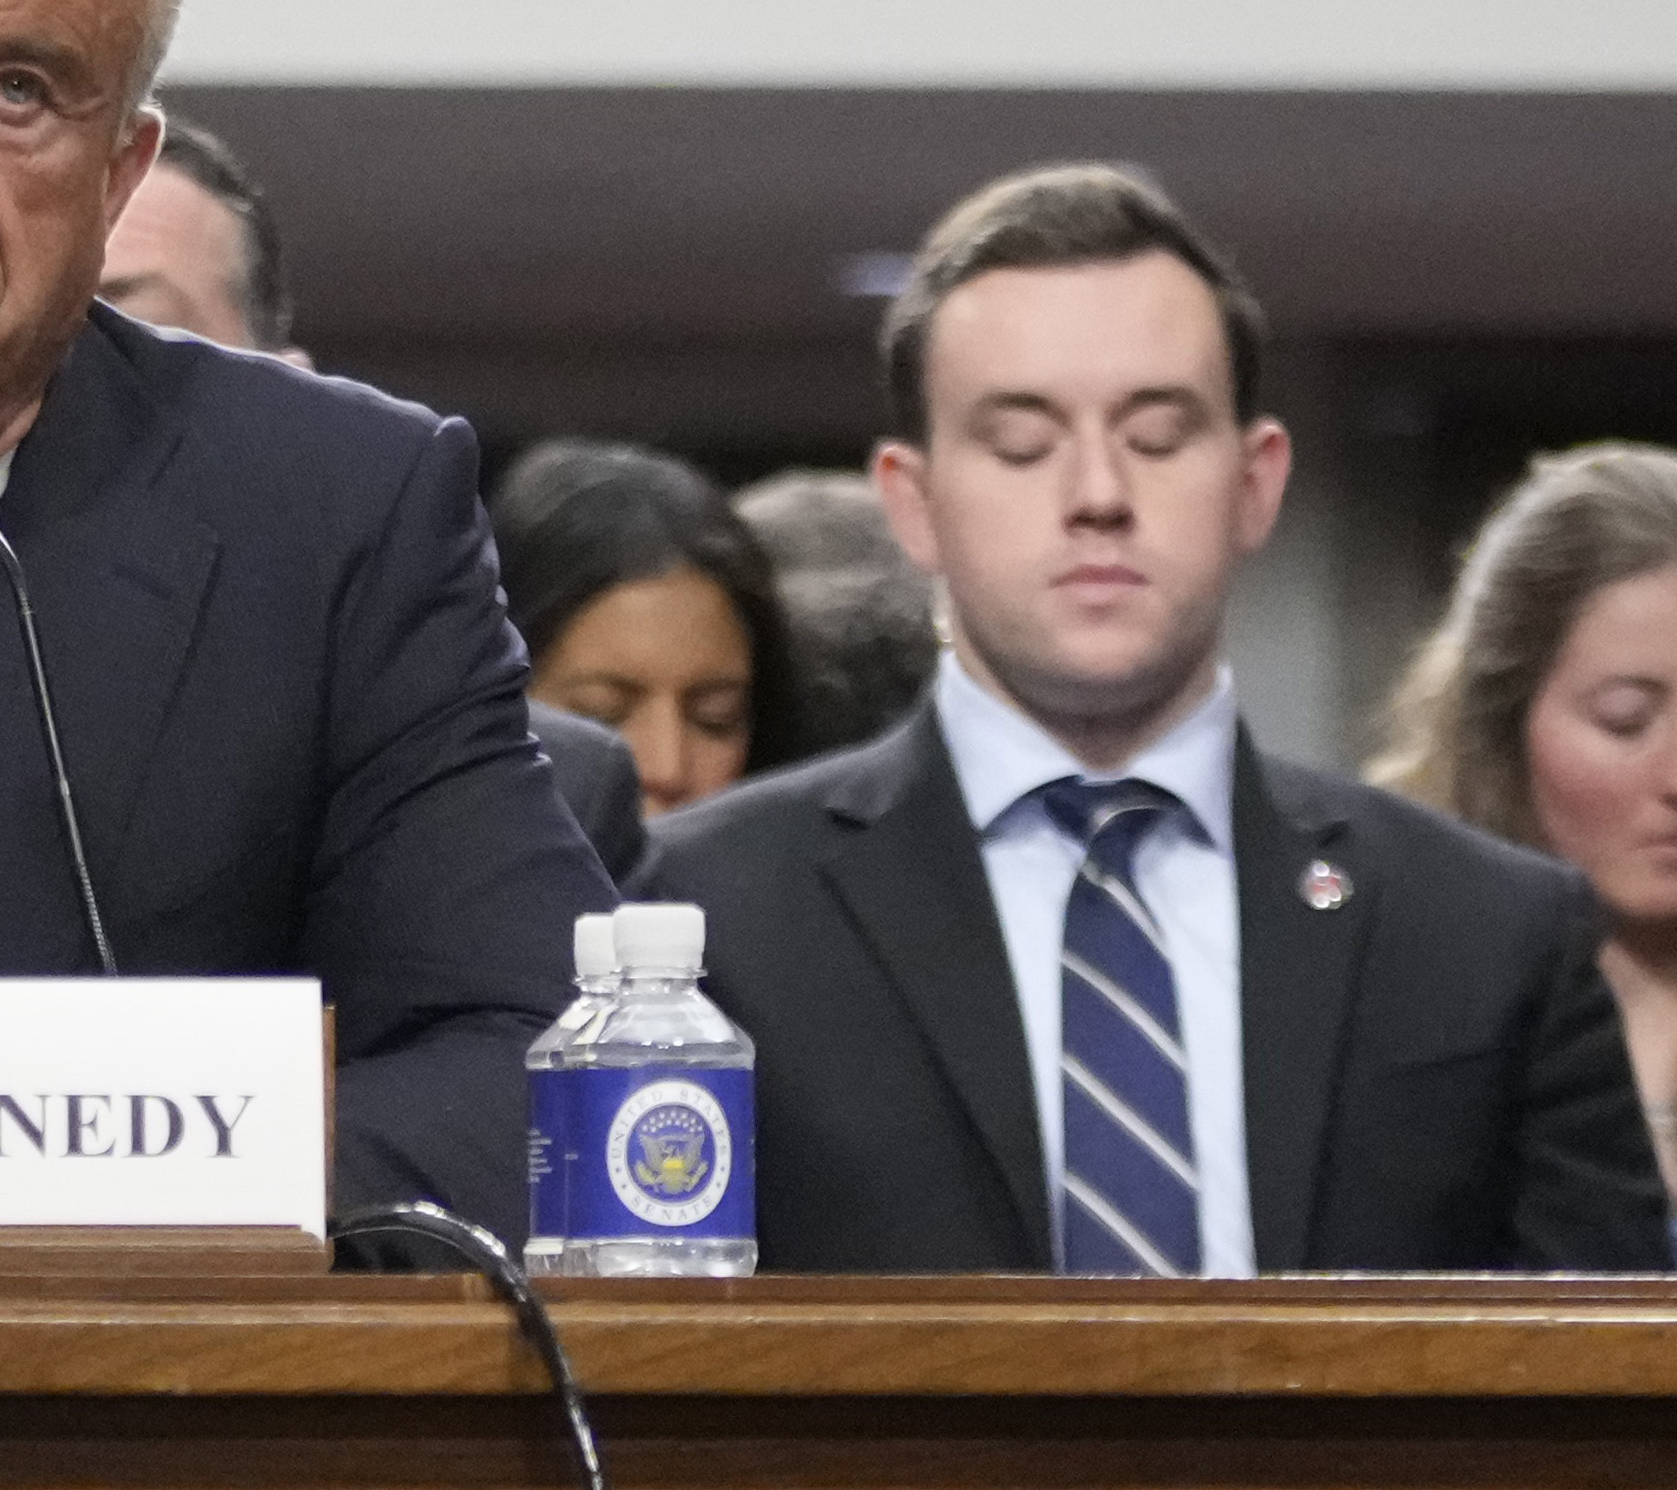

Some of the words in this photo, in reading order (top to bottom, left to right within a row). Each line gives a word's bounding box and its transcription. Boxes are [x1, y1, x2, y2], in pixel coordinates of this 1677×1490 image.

[611, 1090, 663, 1159] UNITED
[679, 1090, 726, 1156] STATES
[631, 1195, 713, 1221] SENATE
